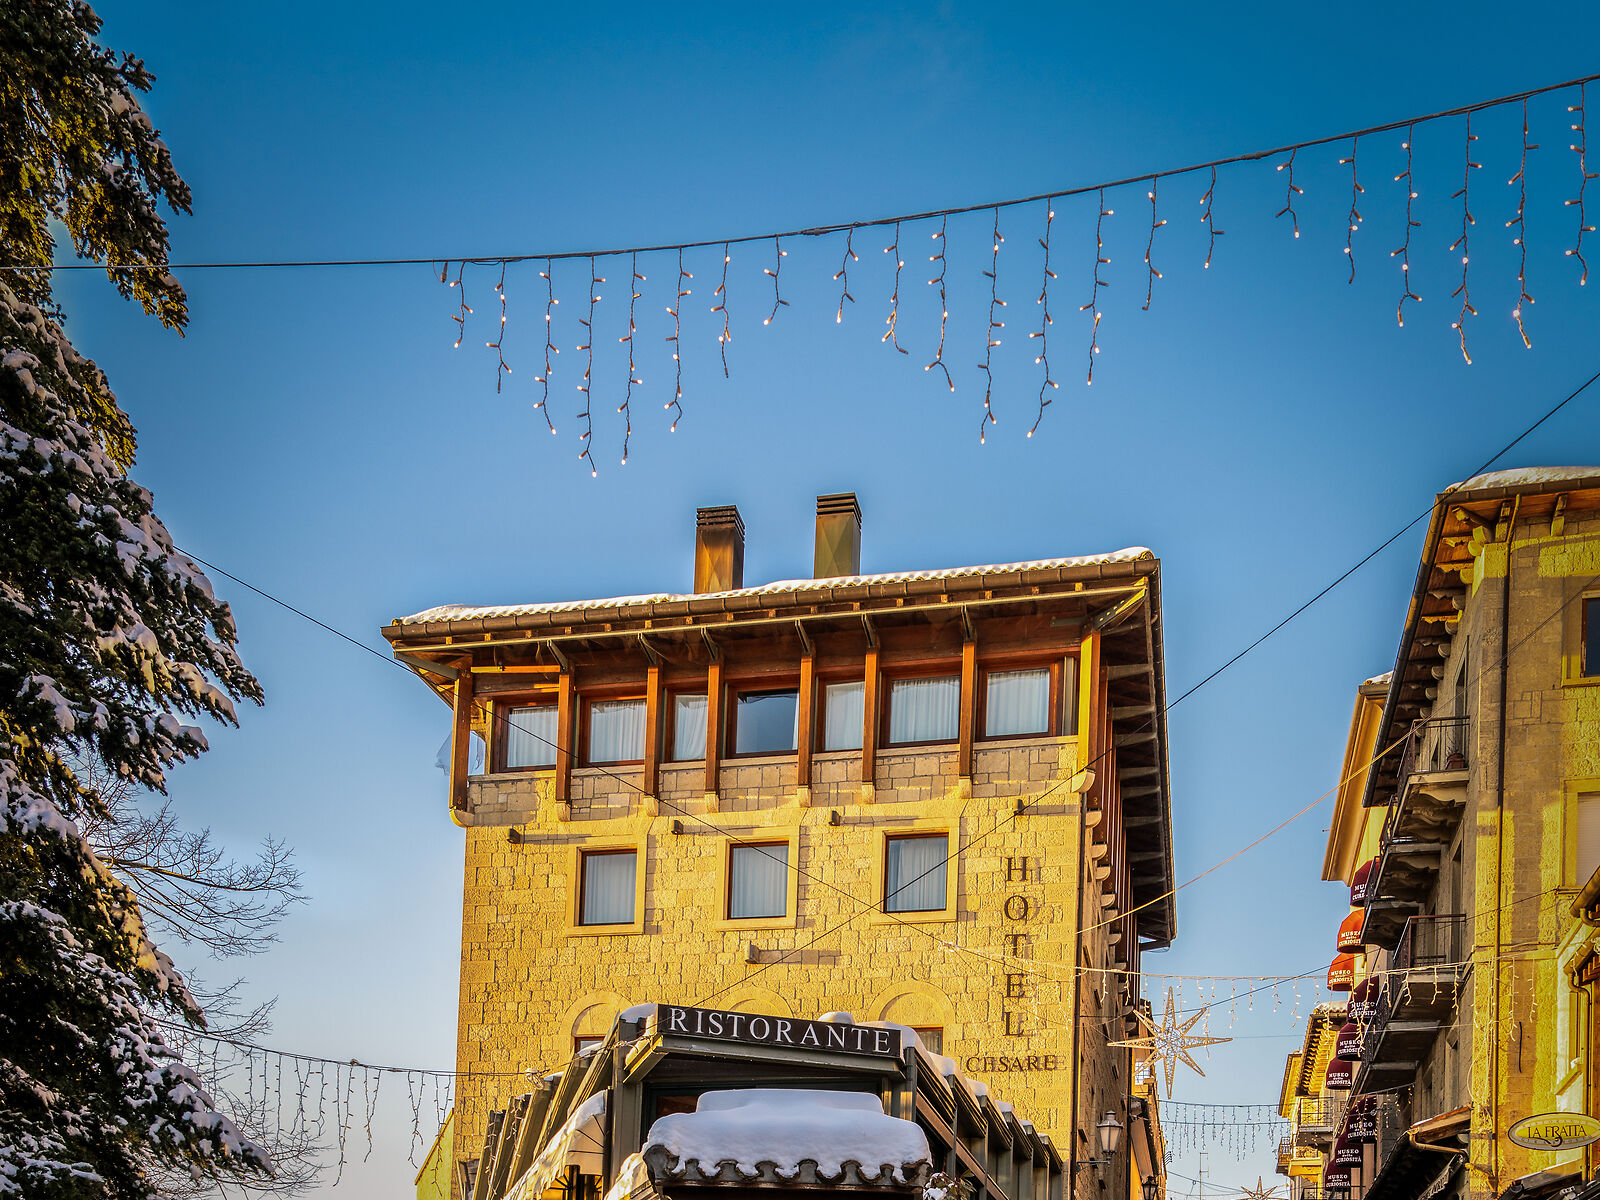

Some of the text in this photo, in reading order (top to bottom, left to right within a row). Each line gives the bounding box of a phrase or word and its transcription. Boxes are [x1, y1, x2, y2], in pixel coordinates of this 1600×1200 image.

[1004, 857, 1029, 1037] HOTEL
[669, 1007, 891, 1053] RISTORANTE
[1528, 1126, 1541, 1138] LA
[1545, 1125, 1587, 1141] FRATTA
